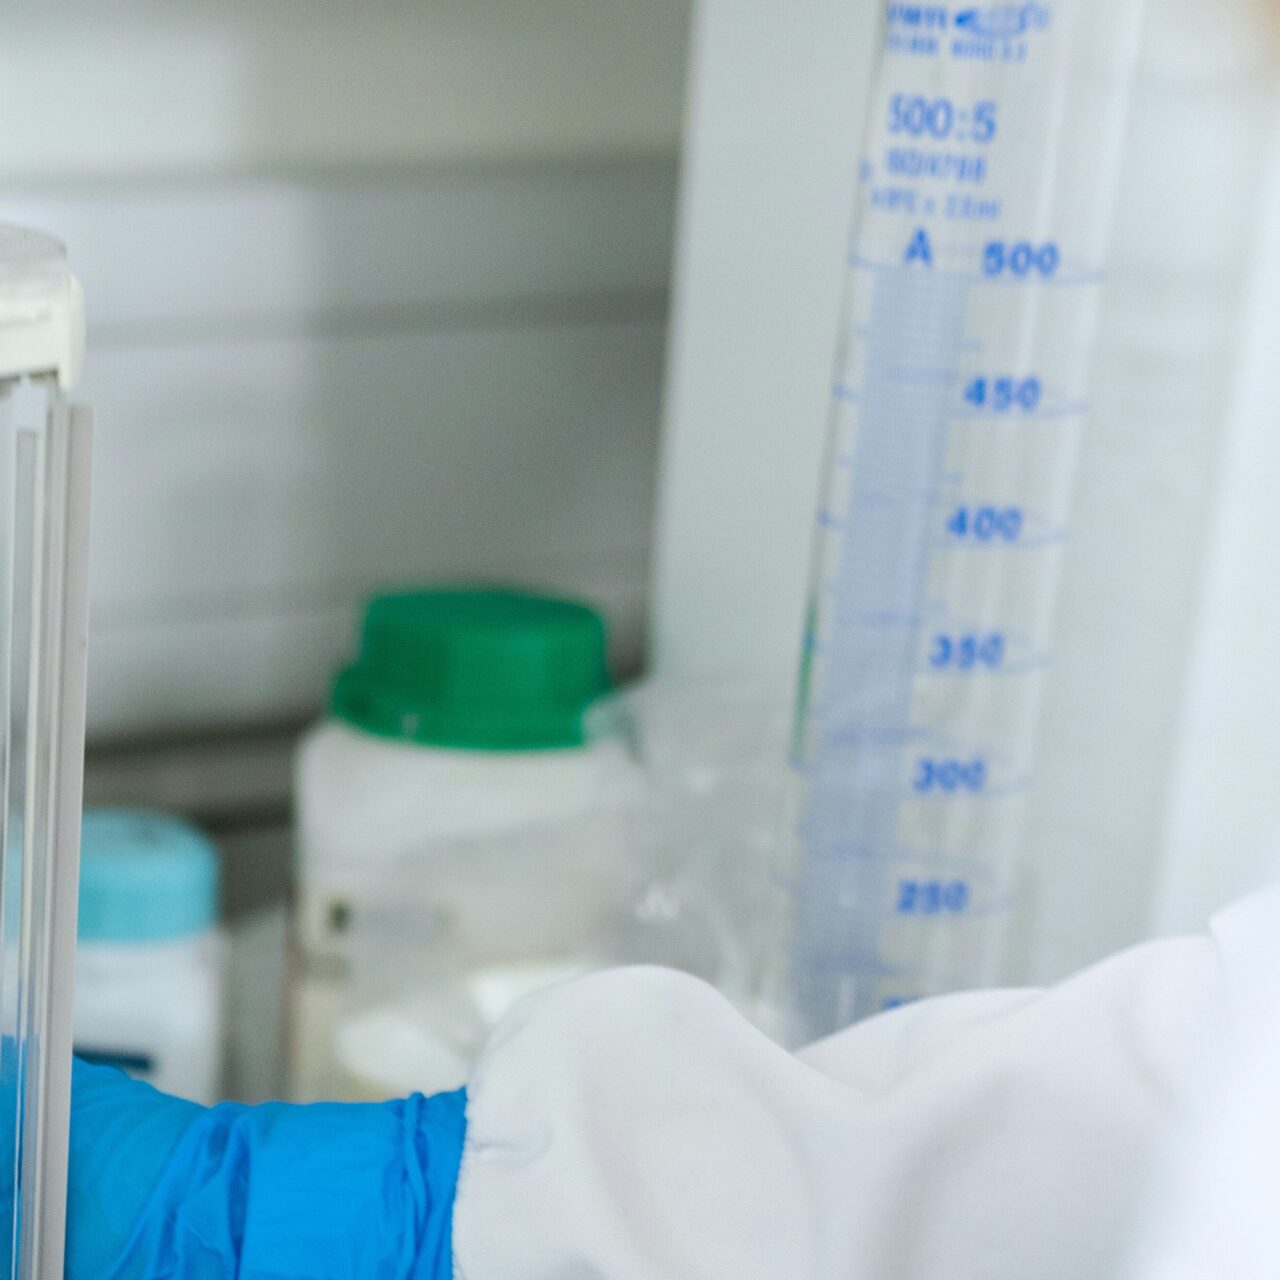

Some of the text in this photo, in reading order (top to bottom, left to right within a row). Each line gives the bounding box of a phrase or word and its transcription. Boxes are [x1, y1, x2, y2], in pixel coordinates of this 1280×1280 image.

[905, 229, 1059, 279] A 500
[964, 375, 1041, 410] 450
[947, 507, 1023, 542] 400
[931, 632, 1004, 671] 350
[914, 758, 987, 793] 300
[897, 879, 968, 914] 250
